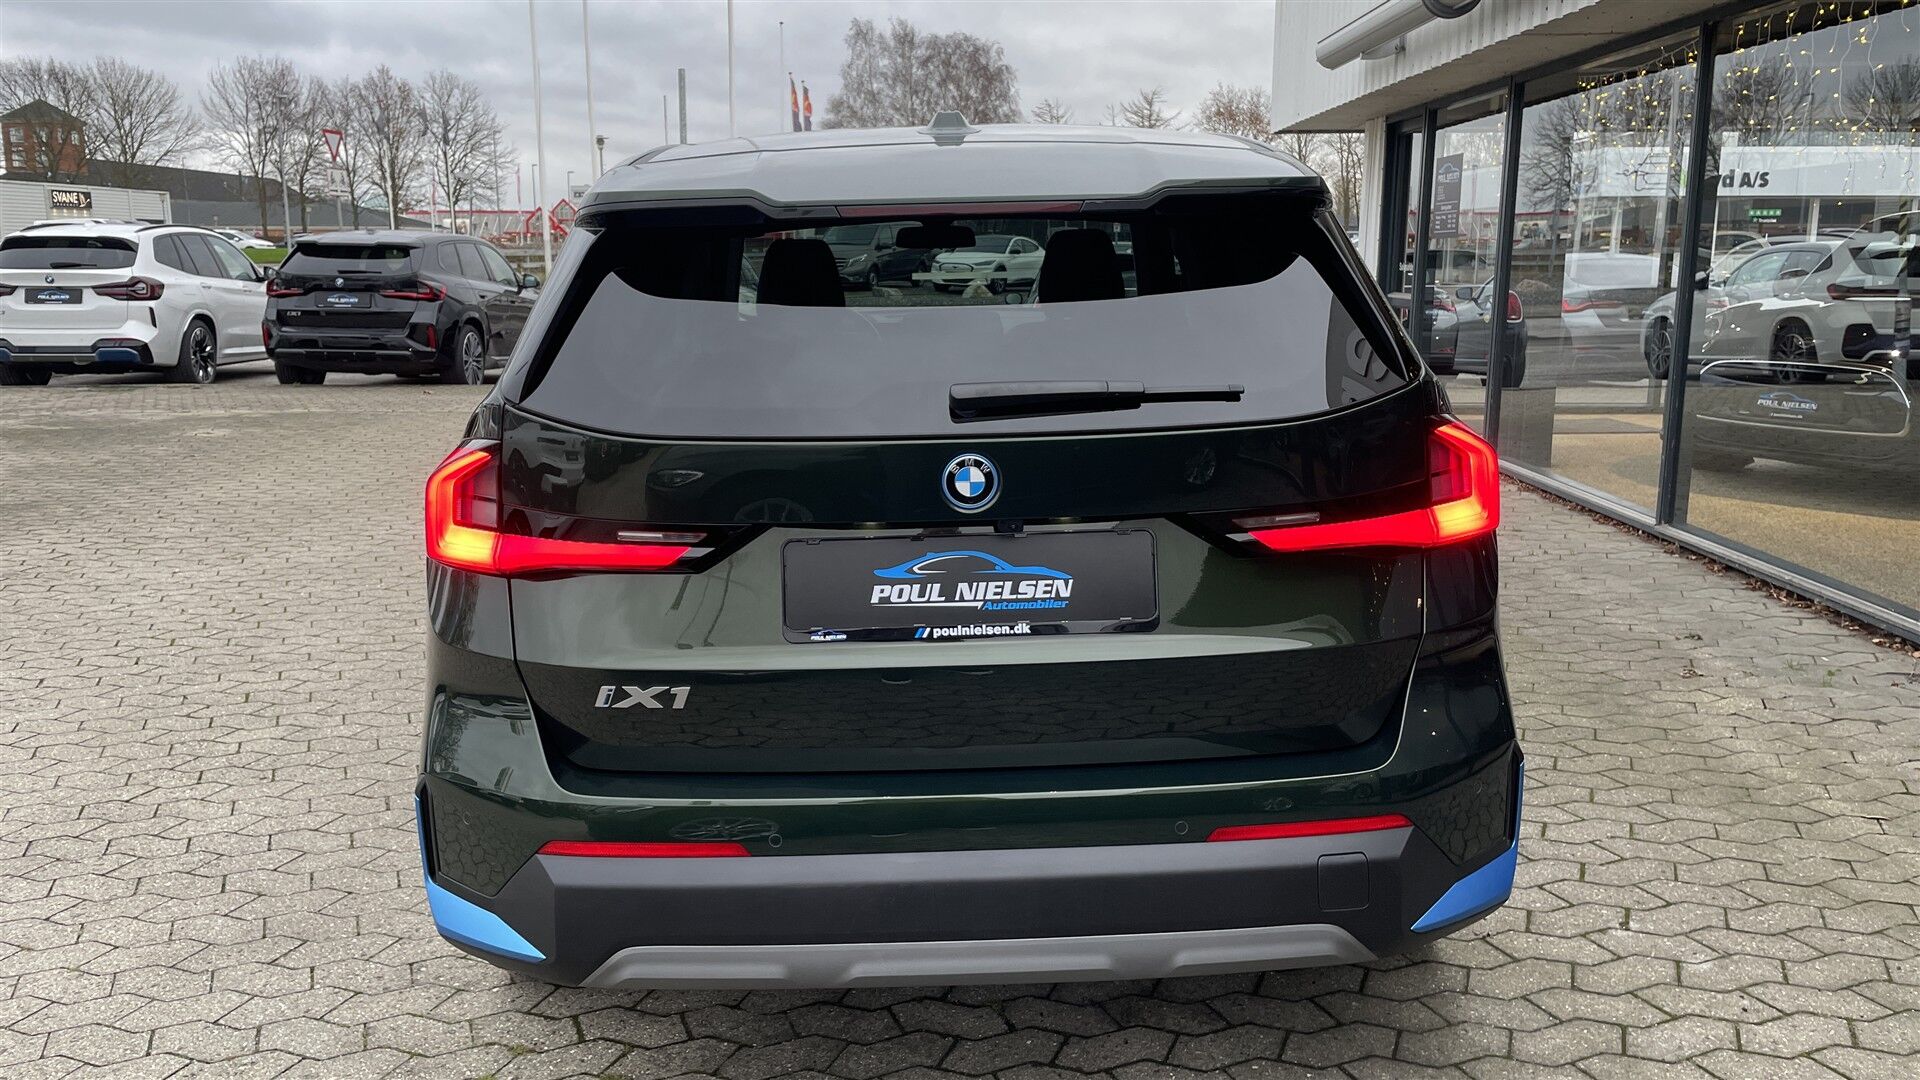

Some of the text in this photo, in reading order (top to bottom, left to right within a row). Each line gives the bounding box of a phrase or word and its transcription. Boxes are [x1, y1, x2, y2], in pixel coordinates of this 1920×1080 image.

[1739, 171, 1770, 188] A/S
[52, 191, 79, 204] SVANE
[1757, 399, 1818, 410] POUL NIELSEN
[950, 458, 991, 474] BMW
[870, 579, 1074, 604] POUL NIELSEN
[982, 600, 1069, 611] Automobiler
[932, 623, 1032, 639] poulnielsen.dk
[594, 685, 691, 709] iX1
